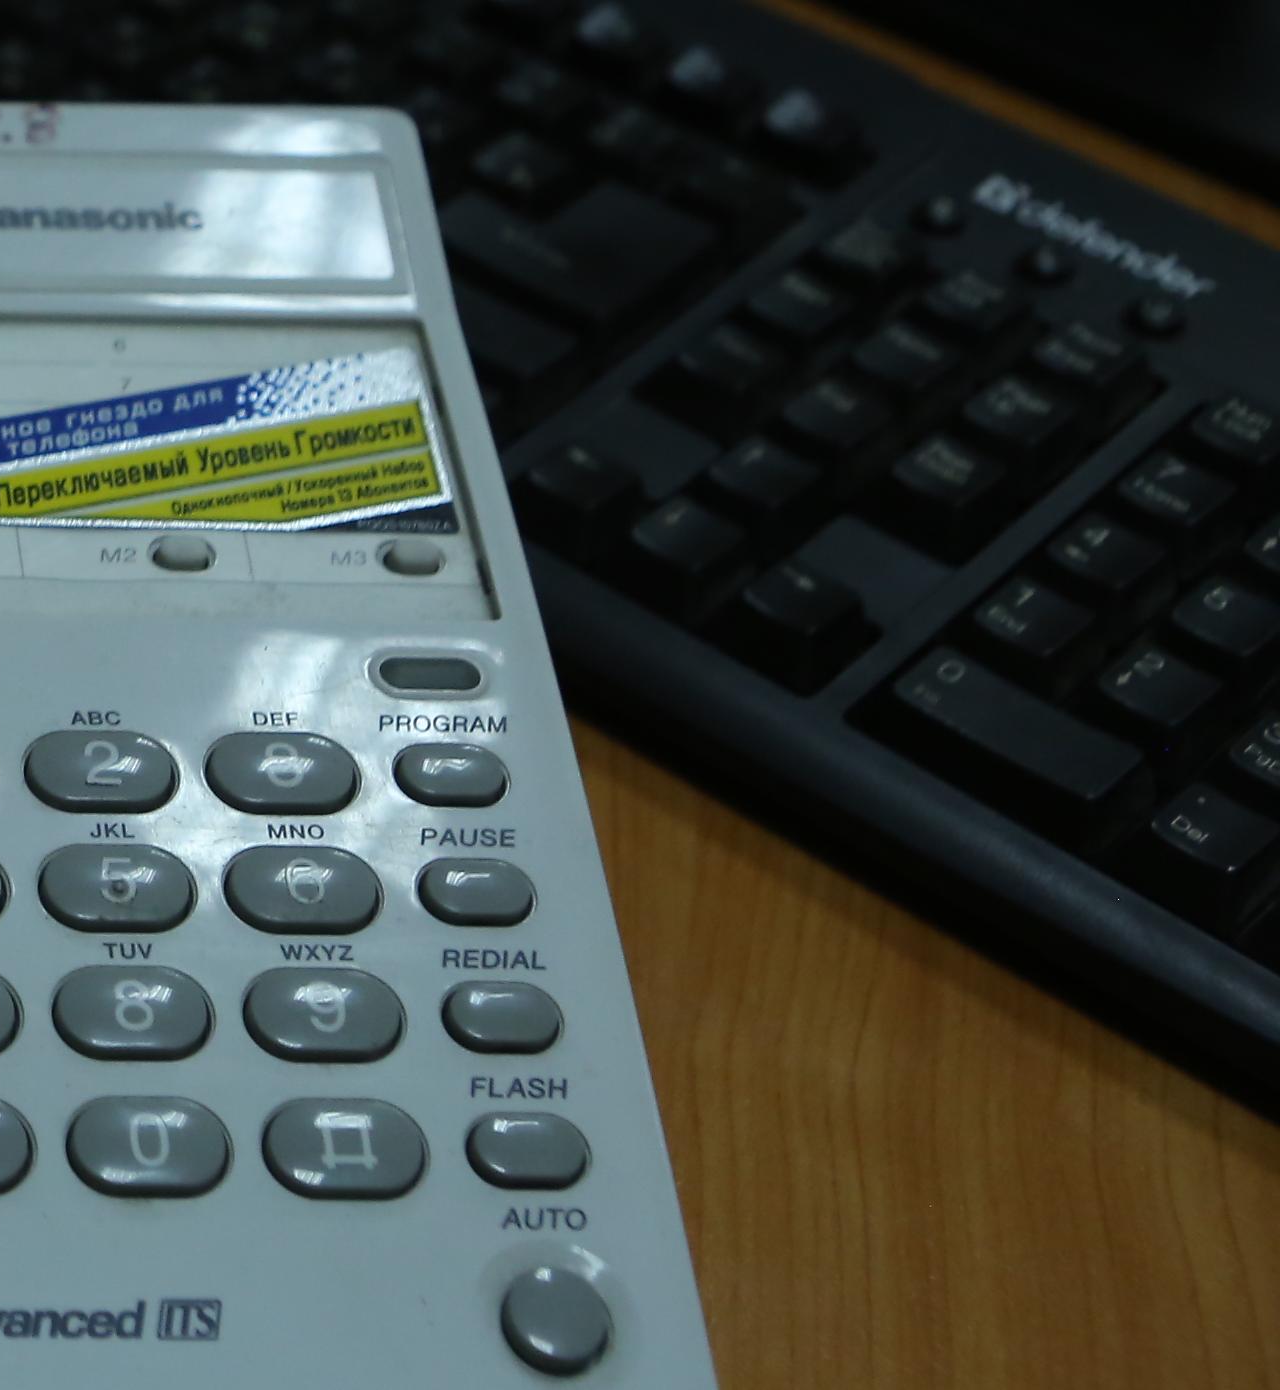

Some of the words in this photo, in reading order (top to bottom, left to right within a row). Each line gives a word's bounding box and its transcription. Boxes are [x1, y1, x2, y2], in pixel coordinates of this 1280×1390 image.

[1016, 182, 1216, 299] defender
[66, 398, 165, 427] гнездо
[174, 387, 225, 413] для
[9, 421, 139, 455] телефона
[196, 439, 291, 476] Уровень
[293, 416, 416, 459] Громкости
[99, 546, 138, 564] M2
[330, 547, 368, 566] M3
[71, 711, 122, 726] ABC
[252, 711, 300, 727] DEF
[378, 714, 508, 734] PROGRAM
[84, 740, 123, 785] 2
[90, 823, 136, 839] JKL
[267, 824, 326, 840] MNO
[420, 827, 517, 848] PAUSE
[1169, 813, 1211, 845] Del
[100, 857, 137, 902] 5
[285, 857, 325, 904] 6
[102, 942, 153, 960] TUV
[280, 944, 355, 961] WXYZ
[441, 950, 547, 970] REDIAL
[113, 979, 156, 1031] 8
[305, 981, 347, 1033] 9
[470, 1077, 568, 1099] FLASH
[129, 1112, 170, 1167] 0
[501, 1207, 588, 1231] AUTO
[161, 1299, 220, 1339] ITS
